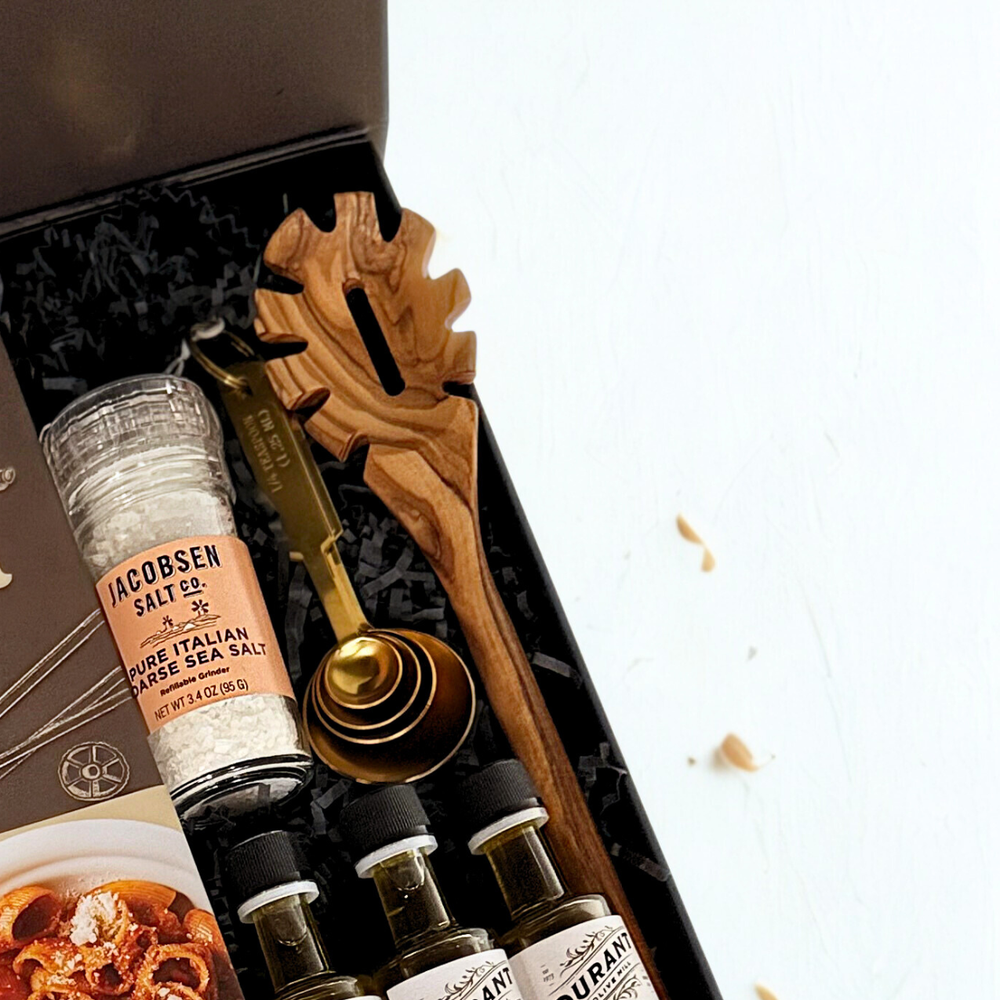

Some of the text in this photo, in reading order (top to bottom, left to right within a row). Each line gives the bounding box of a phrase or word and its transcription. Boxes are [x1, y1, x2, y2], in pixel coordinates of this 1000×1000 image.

[243, 414, 273, 471] TEASPOON
[108, 545, 222, 608] JACOBSEN
[134, 584, 176, 617] SALT
[129, 627, 248, 682] PURE ITALIAN
[131, 643, 266, 699] OARSE SEA SALT
[160, 667, 230, 696] Refillable Grinder
[154, 679, 249, 721] NET WT 3.4 OZ (95 G)
